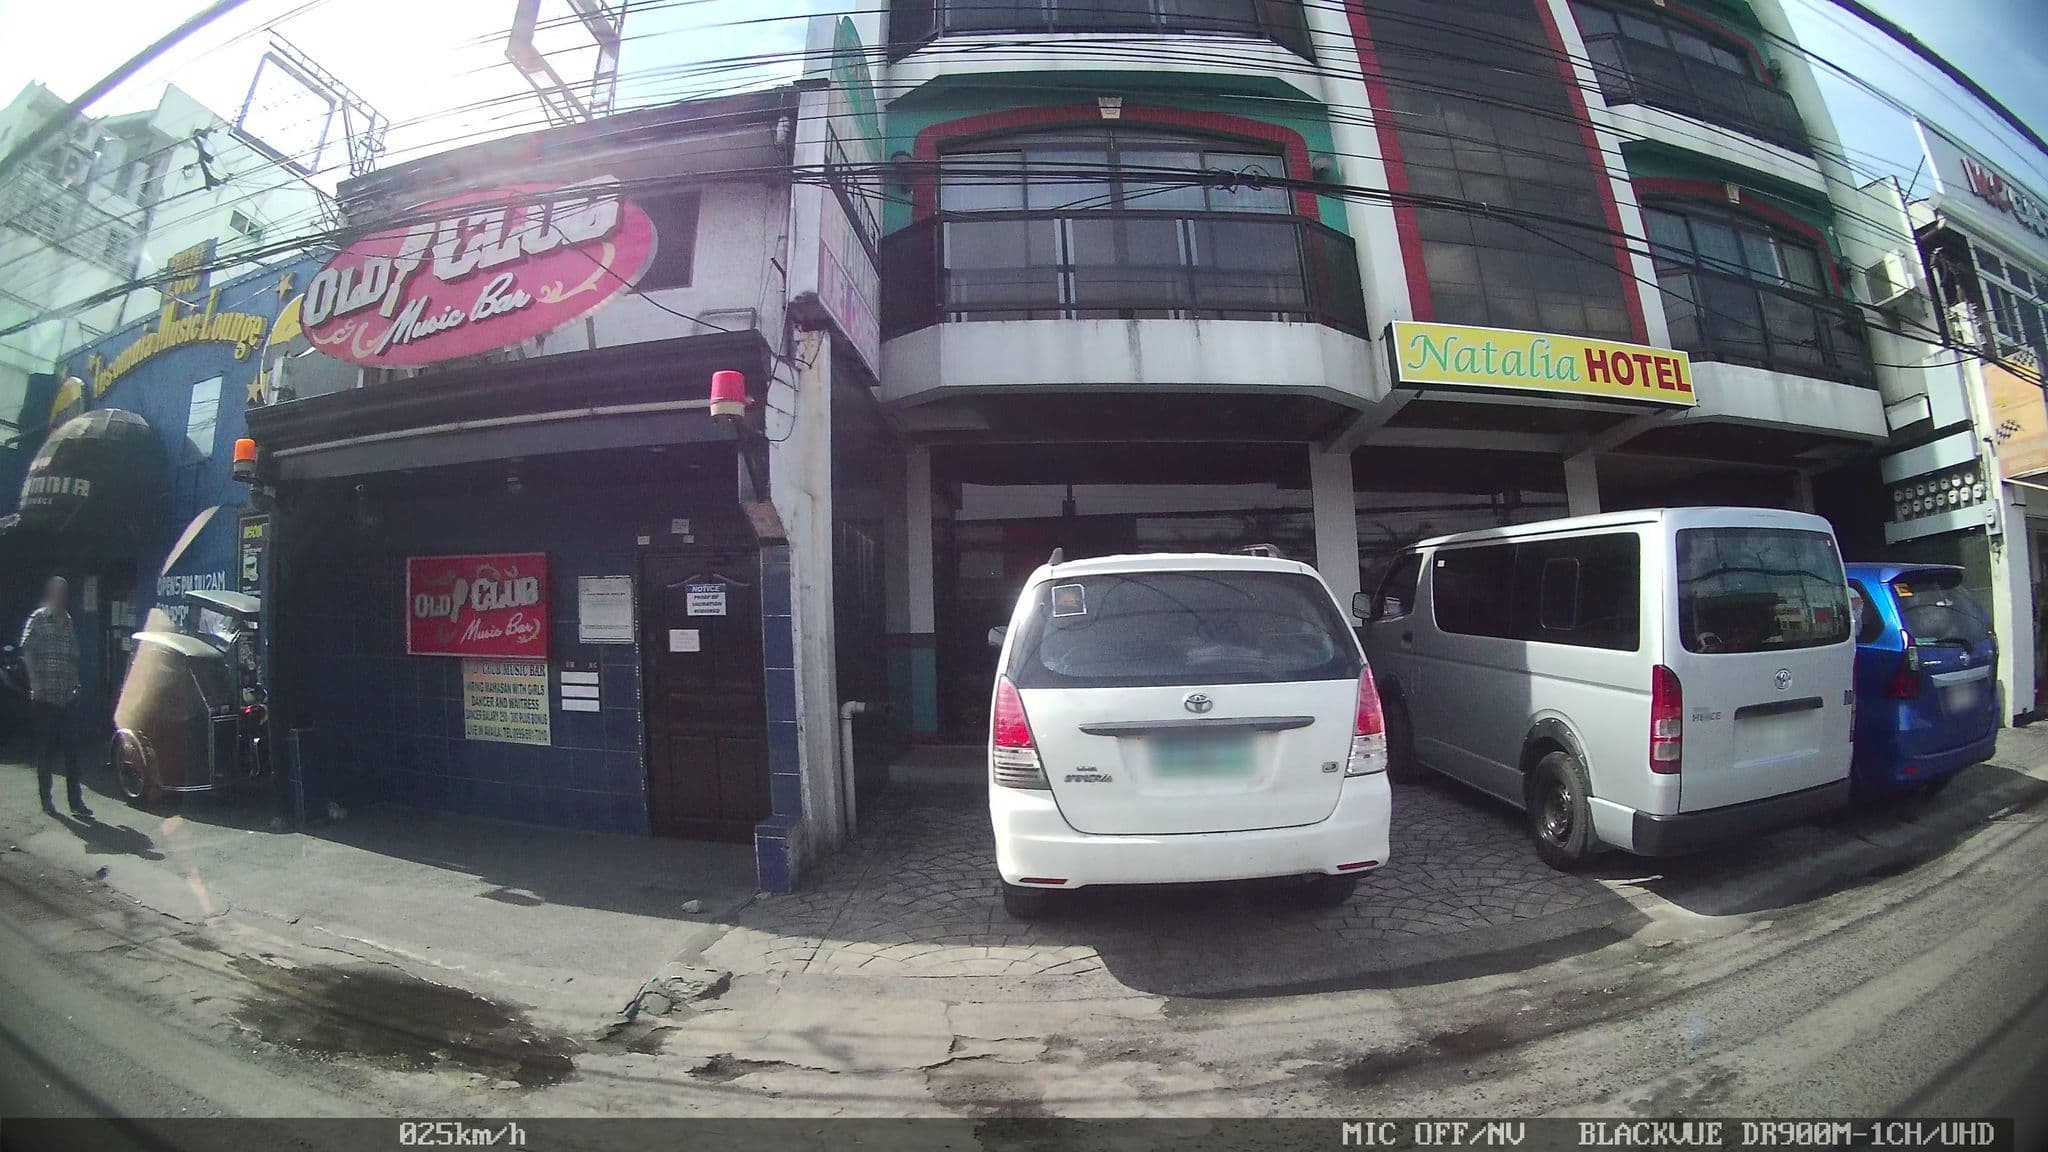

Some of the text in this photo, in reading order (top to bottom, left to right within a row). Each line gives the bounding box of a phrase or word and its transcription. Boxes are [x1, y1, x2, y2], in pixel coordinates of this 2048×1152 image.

[303, 259, 392, 327] OLD
[375, 272, 532, 355] Music Bar
[157, 300, 202, 353] Music
[1407, 334, 1692, 393] Natalia HOTEL
[415, 576, 539, 618] OLD CLUB
[691, 585, 721, 593] NOTICE
[460, 612, 533, 644] Music Bar
[503, 664, 528, 676] MUSIC
[529, 665, 545, 677] BAR
[495, 696, 508, 708] AND
